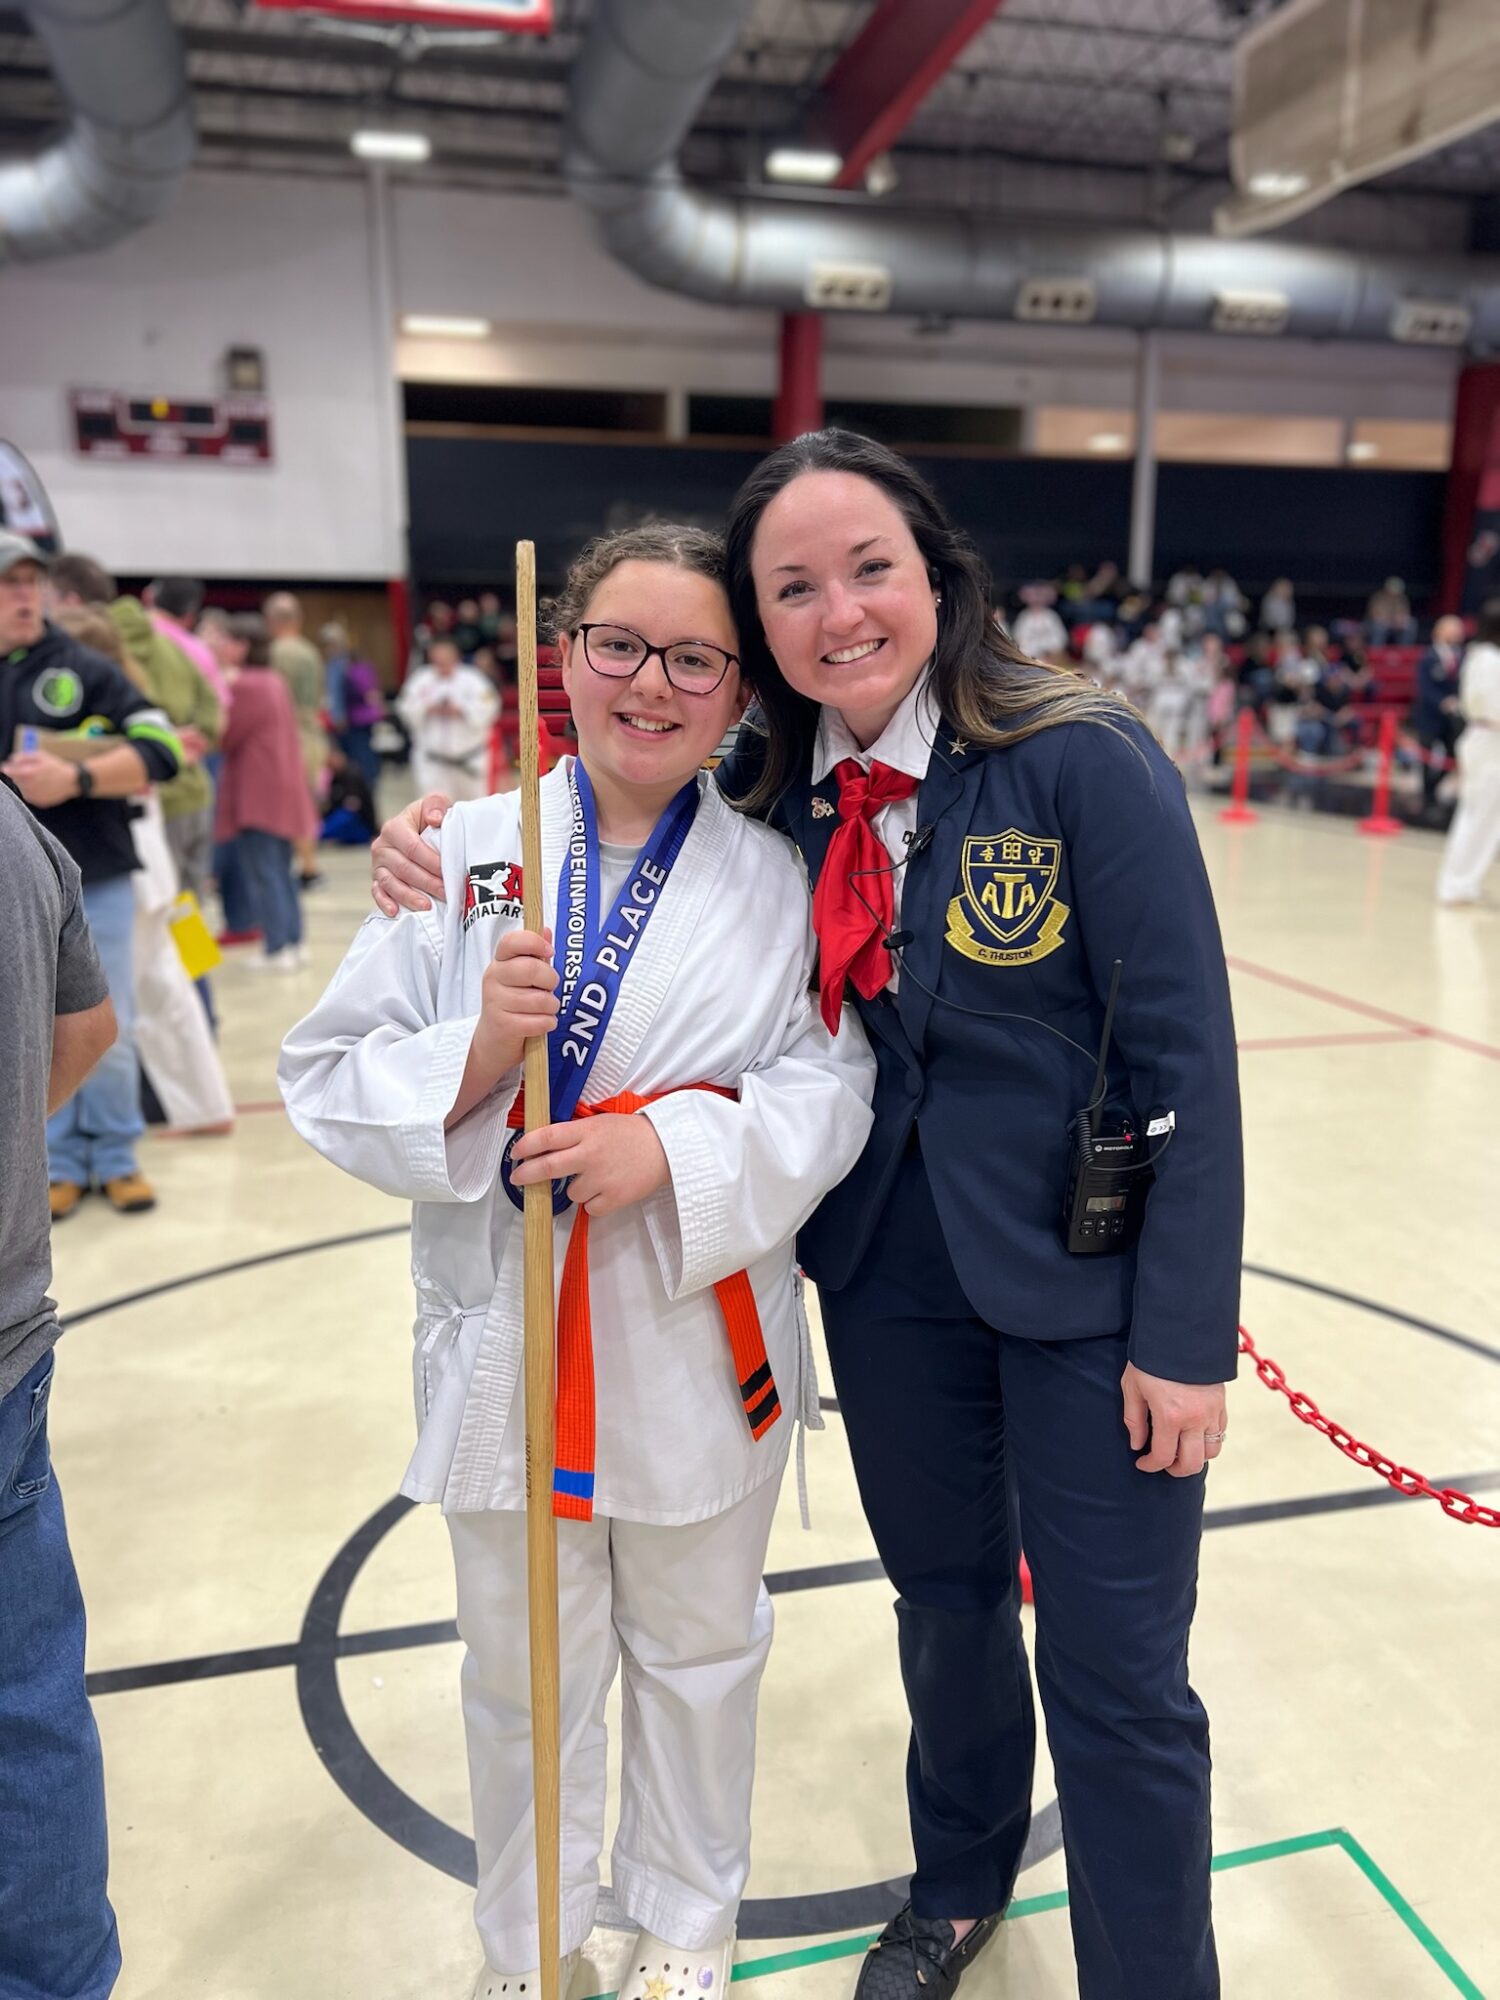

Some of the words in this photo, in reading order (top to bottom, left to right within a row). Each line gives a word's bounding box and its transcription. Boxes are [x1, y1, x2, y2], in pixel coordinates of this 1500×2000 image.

[569, 876, 587, 898] IN
[981, 872, 1036, 919] ATA
[501, 903, 525, 919] AR
[562, 982, 608, 1067] 2ND
[596, 858, 667, 973] PLACE
